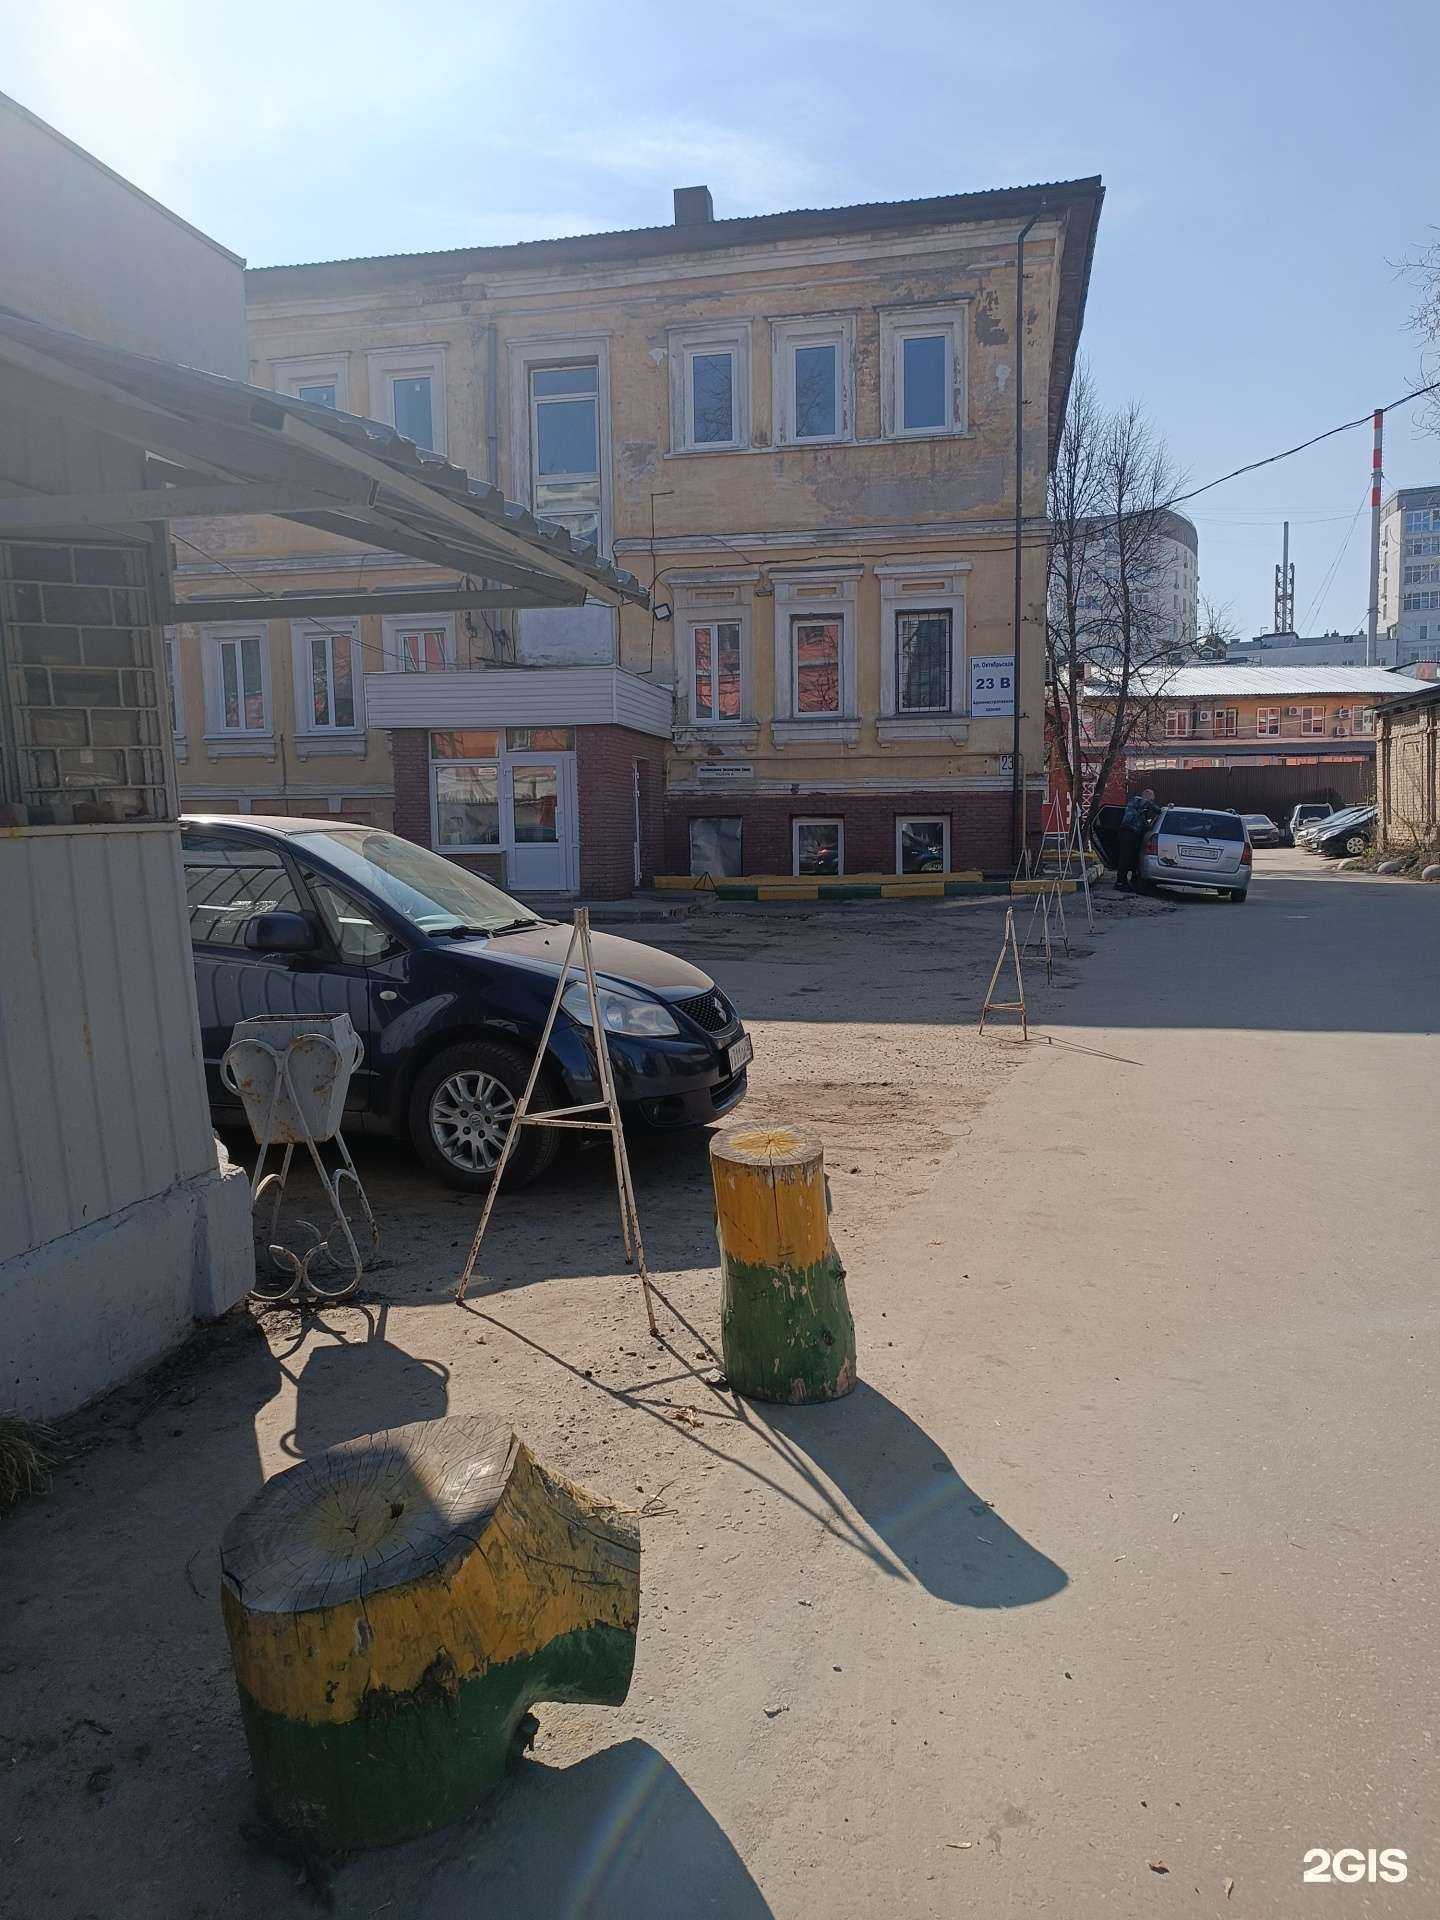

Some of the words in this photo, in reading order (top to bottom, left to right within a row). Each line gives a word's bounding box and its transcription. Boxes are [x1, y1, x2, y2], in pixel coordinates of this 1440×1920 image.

[976, 678, 995, 690] 23
[1001, 677, 1011, 689] В
[1002, 755, 1014, 769] 23
